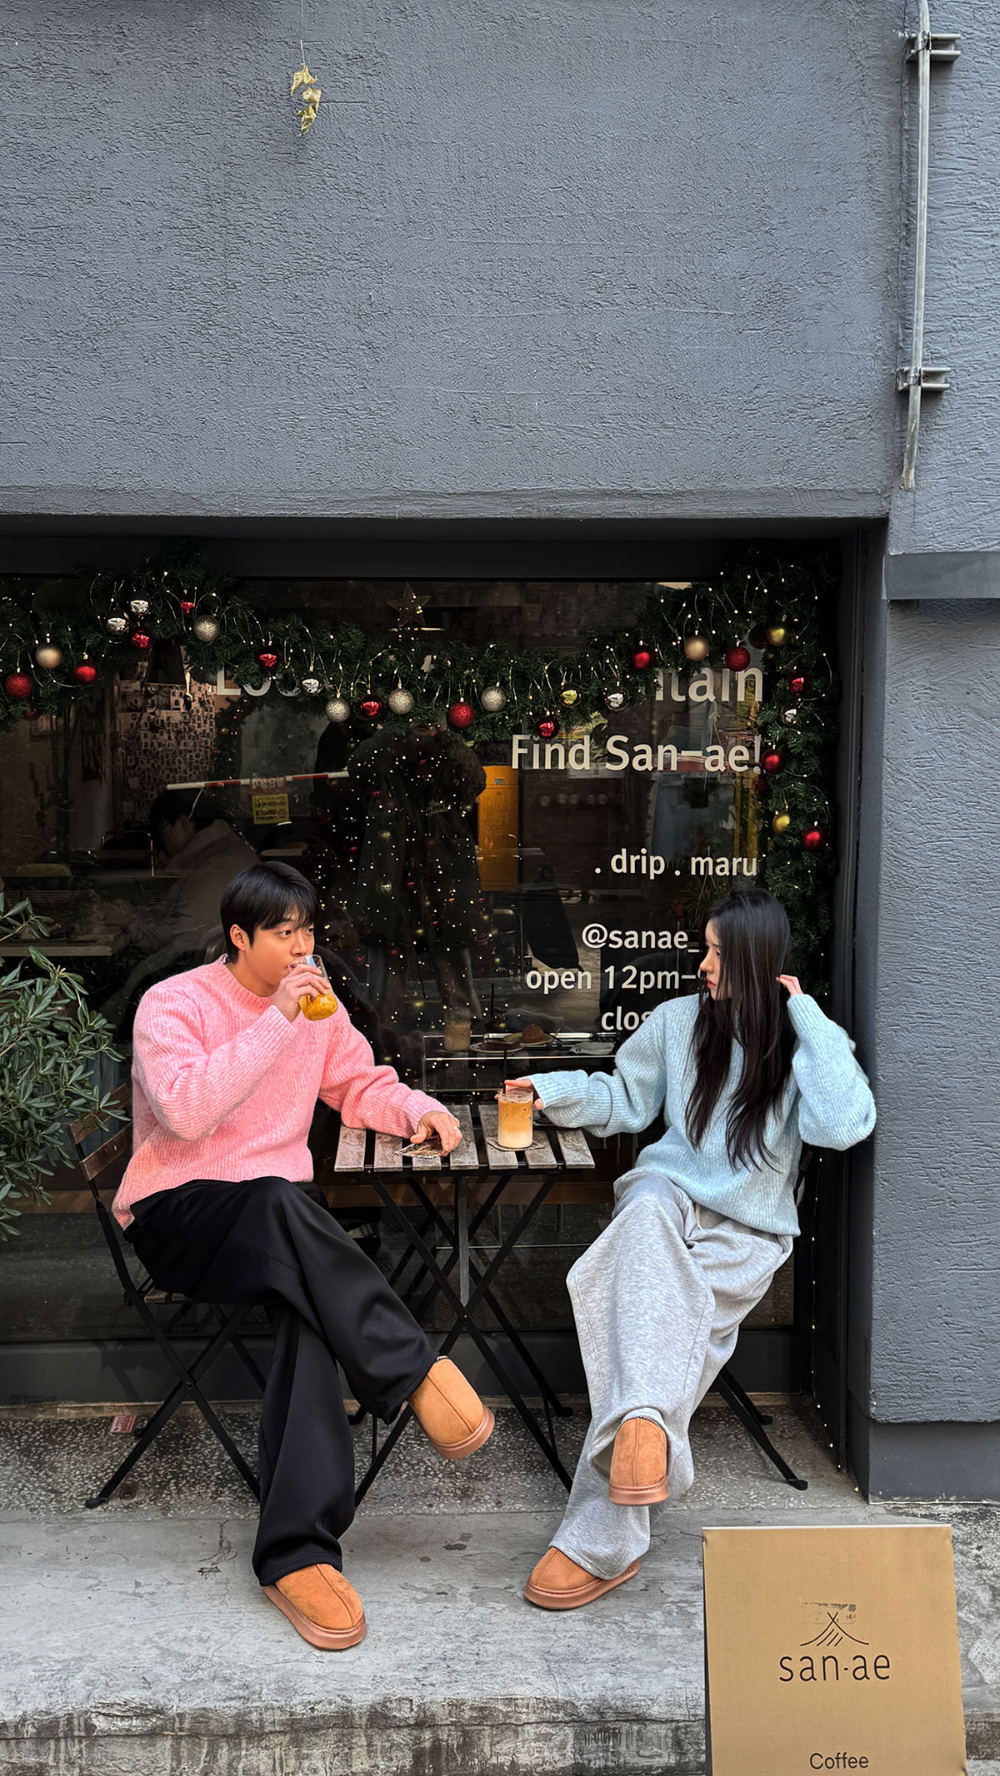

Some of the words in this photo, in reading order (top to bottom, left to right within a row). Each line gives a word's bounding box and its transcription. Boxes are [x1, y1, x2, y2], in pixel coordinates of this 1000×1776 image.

[511, 734, 592, 771] Find
[610, 847, 666, 880] drip
[691, 856, 758, 877] maru
[525, 969, 593, 995] open
[809, 1752, 870, 1770] Coffee
